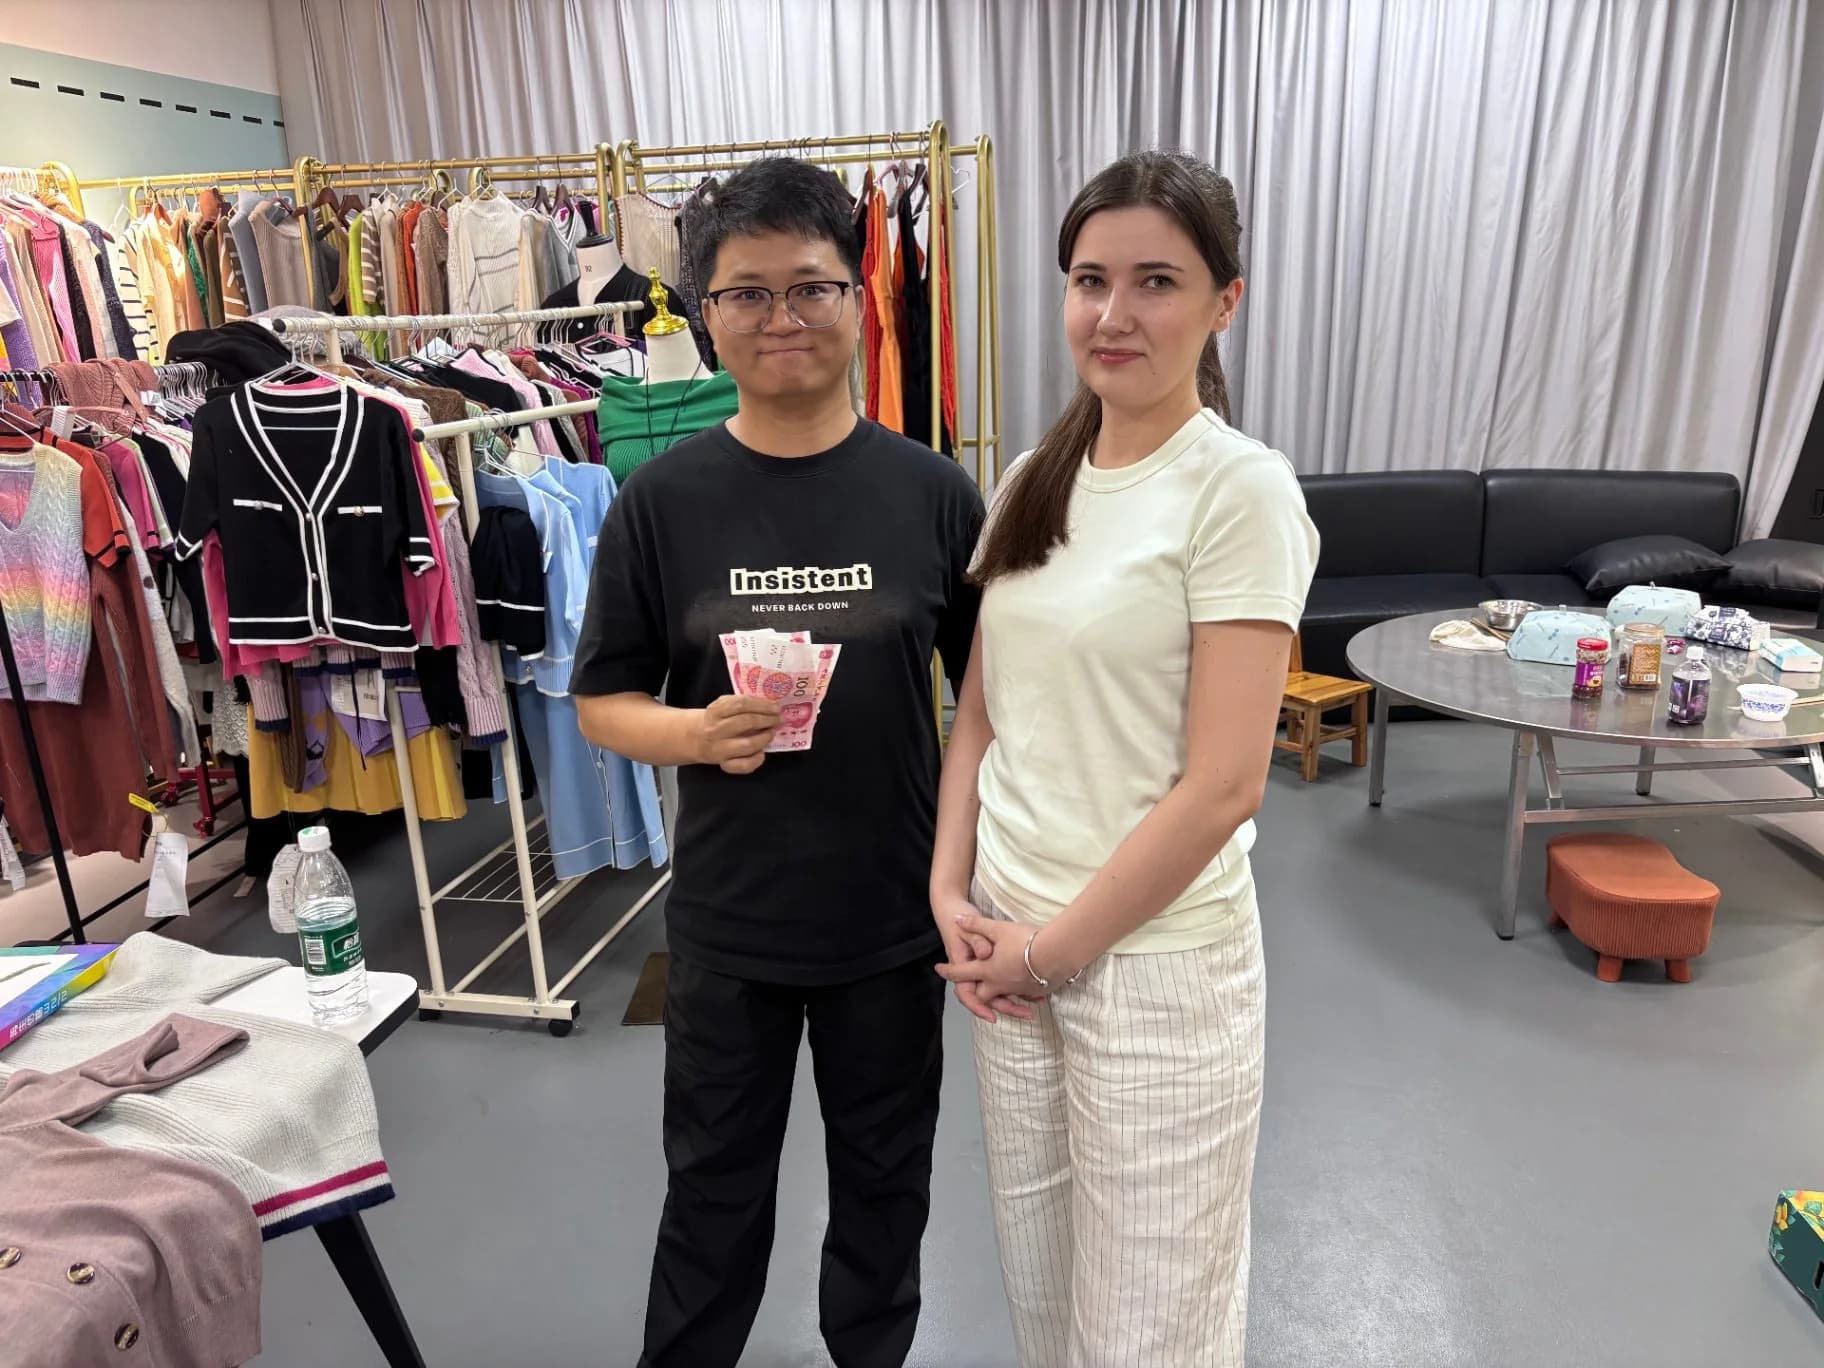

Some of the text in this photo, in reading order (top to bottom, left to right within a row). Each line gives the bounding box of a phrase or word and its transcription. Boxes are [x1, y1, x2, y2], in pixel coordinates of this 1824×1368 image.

[730, 563, 873, 595] Insistent
[751, 601, 849, 613] NEVER BACK DOWN
[793, 676, 809, 697] 100
[790, 740, 807, 749] 100
